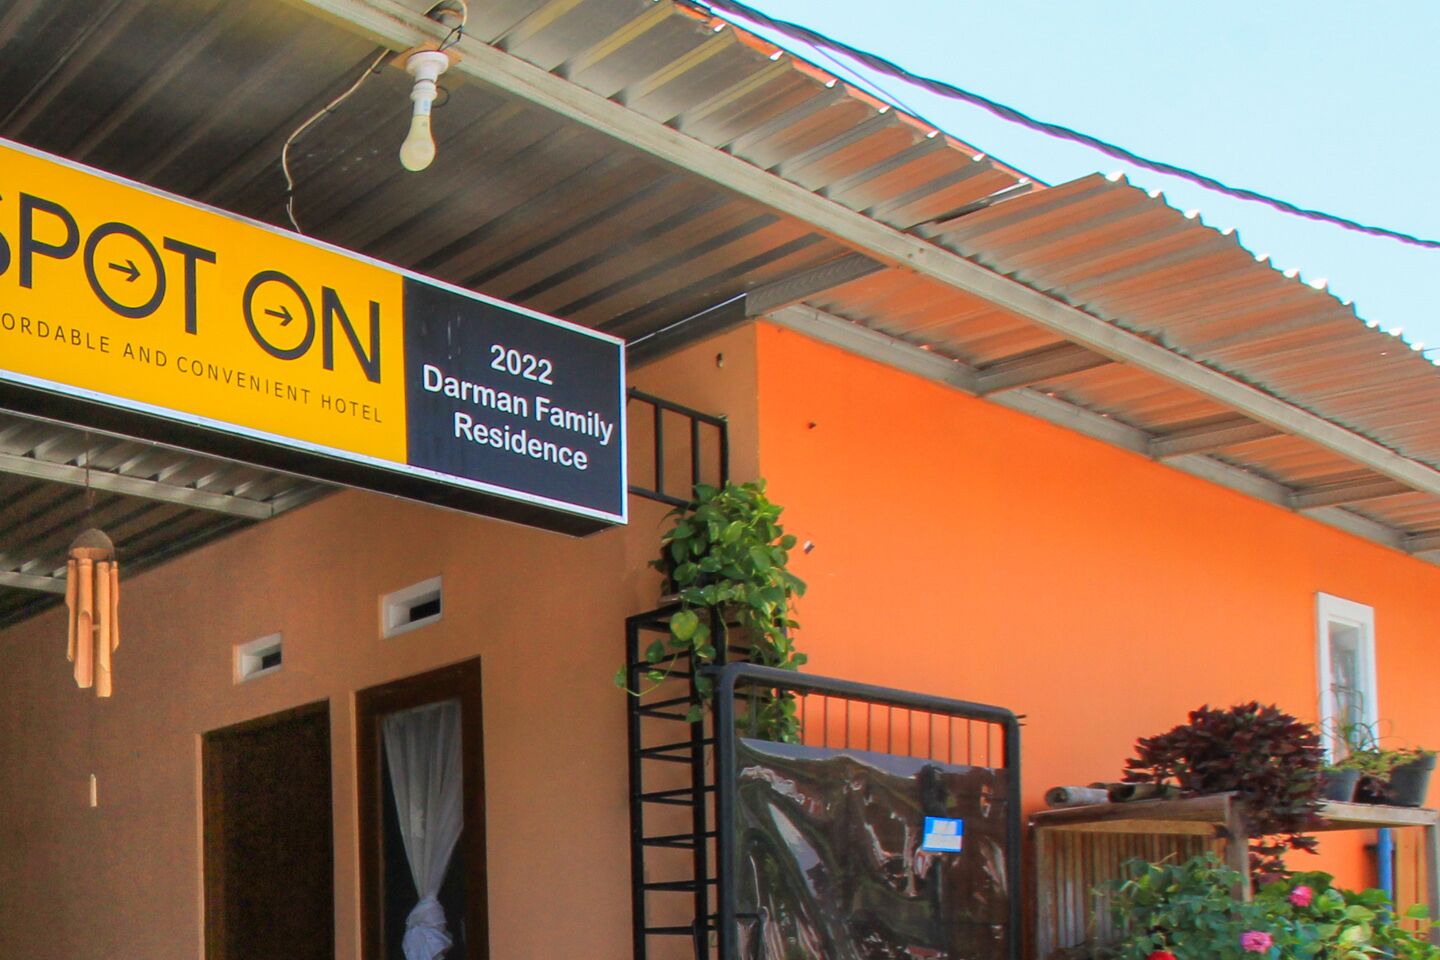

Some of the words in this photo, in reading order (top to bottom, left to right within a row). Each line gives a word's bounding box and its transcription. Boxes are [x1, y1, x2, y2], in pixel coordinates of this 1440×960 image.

[242, 270, 381, 385] ON
[490, 344, 553, 386] 2022
[123, 342, 168, 368] AND
[176, 356, 312, 406] CONVENIENT
[321, 393, 383, 425] HOTEL
[423, 364, 528, 417] Darman
[535, 396, 614, 446] Family
[454, 411, 588, 471] Residence
